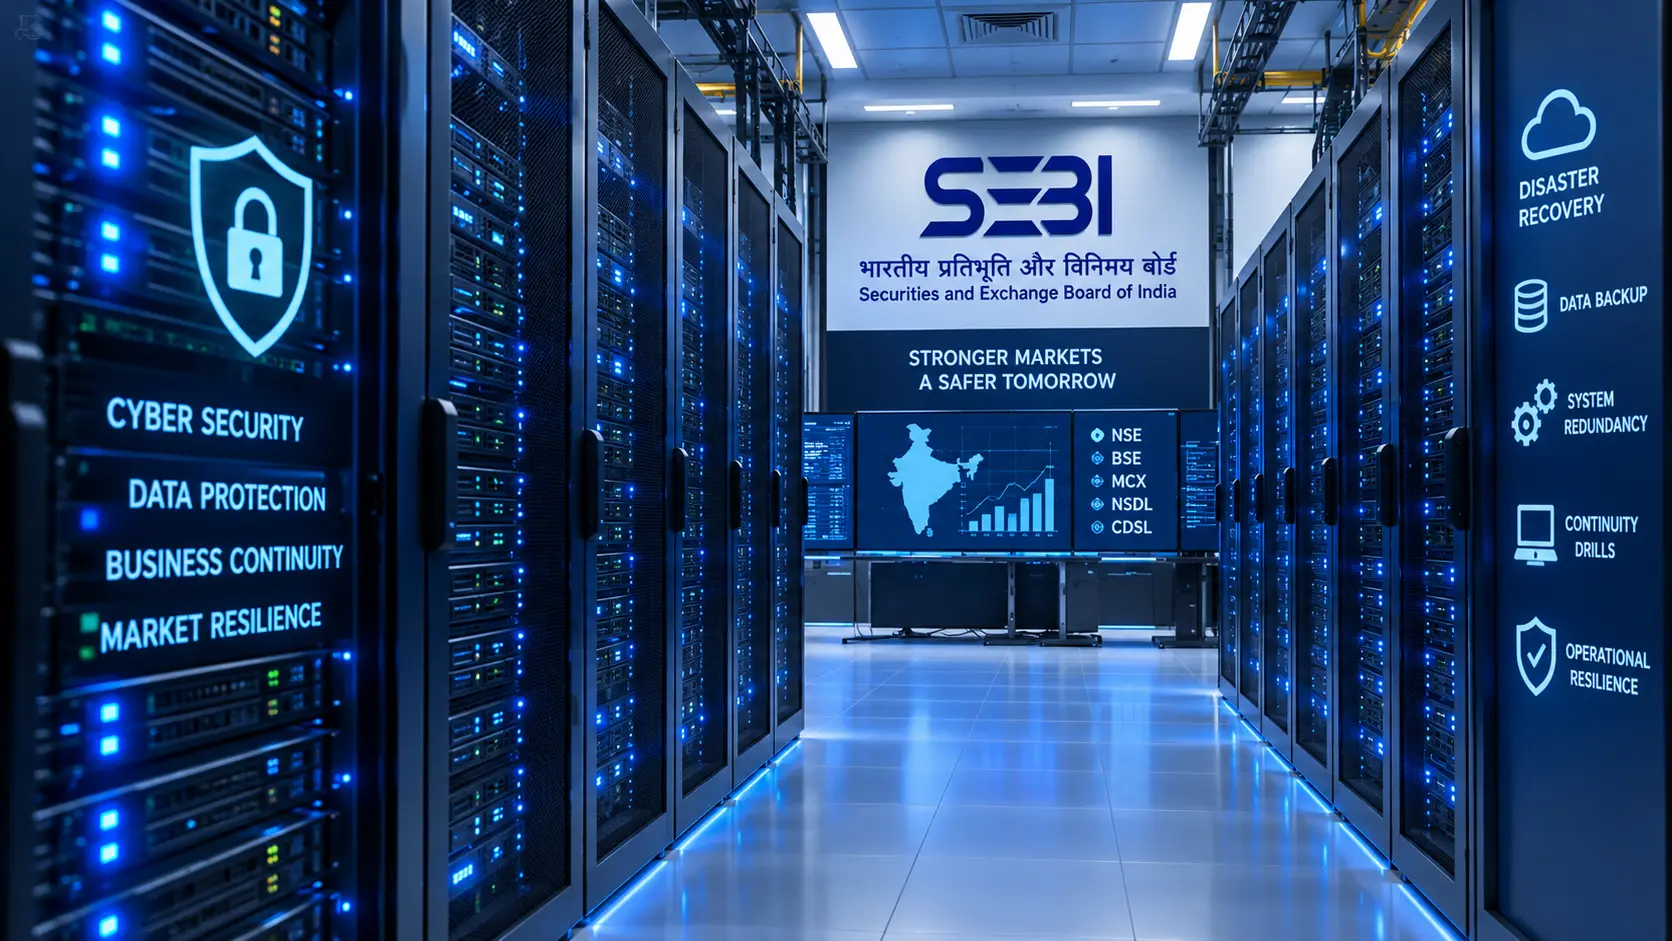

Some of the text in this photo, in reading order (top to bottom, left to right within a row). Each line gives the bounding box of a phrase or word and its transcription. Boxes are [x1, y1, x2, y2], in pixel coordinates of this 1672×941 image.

[1519, 165, 1600, 200] DISASTER
[919, 155, 1113, 238] SEBI
[1518, 193, 1605, 228] RECOVERY
[859, 250, 1178, 283] भारतीय प्रतिभूति और विनिमय बोर्ड
[859, 283, 1177, 304] Securities and Exchange Board of India
[1559, 285, 1648, 313] DATA BACKUP
[909, 348, 1103, 367] STRONGER MARKETS
[918, 372, 1117, 391] A SAFER TOMORROW
[1567, 390, 1615, 410] SYSTEM
[106, 396, 304, 442] CYBER SECURITY
[1564, 414, 1648, 435] REDUNDANCY
[1111, 427, 1142, 442] NSE
[1111, 450, 1142, 466] BSE
[1111, 473, 1147, 489] MCX
[129, 478, 326, 512] DATA PROTECTION
[1111, 496, 1153, 511] NSDL
[1111, 519, 1153, 535] CDSL
[1565, 515, 1639, 533] CONTINUITY
[1575, 541, 1616, 559] DRILLS
[106, 544, 344, 581] BUSINESS CONTINUITY
[100, 601, 322, 654] MARKET RESILIENCE
[1565, 643, 1651, 669] OPERATIONAL
[1570, 670, 1639, 696] RESILIENCE
